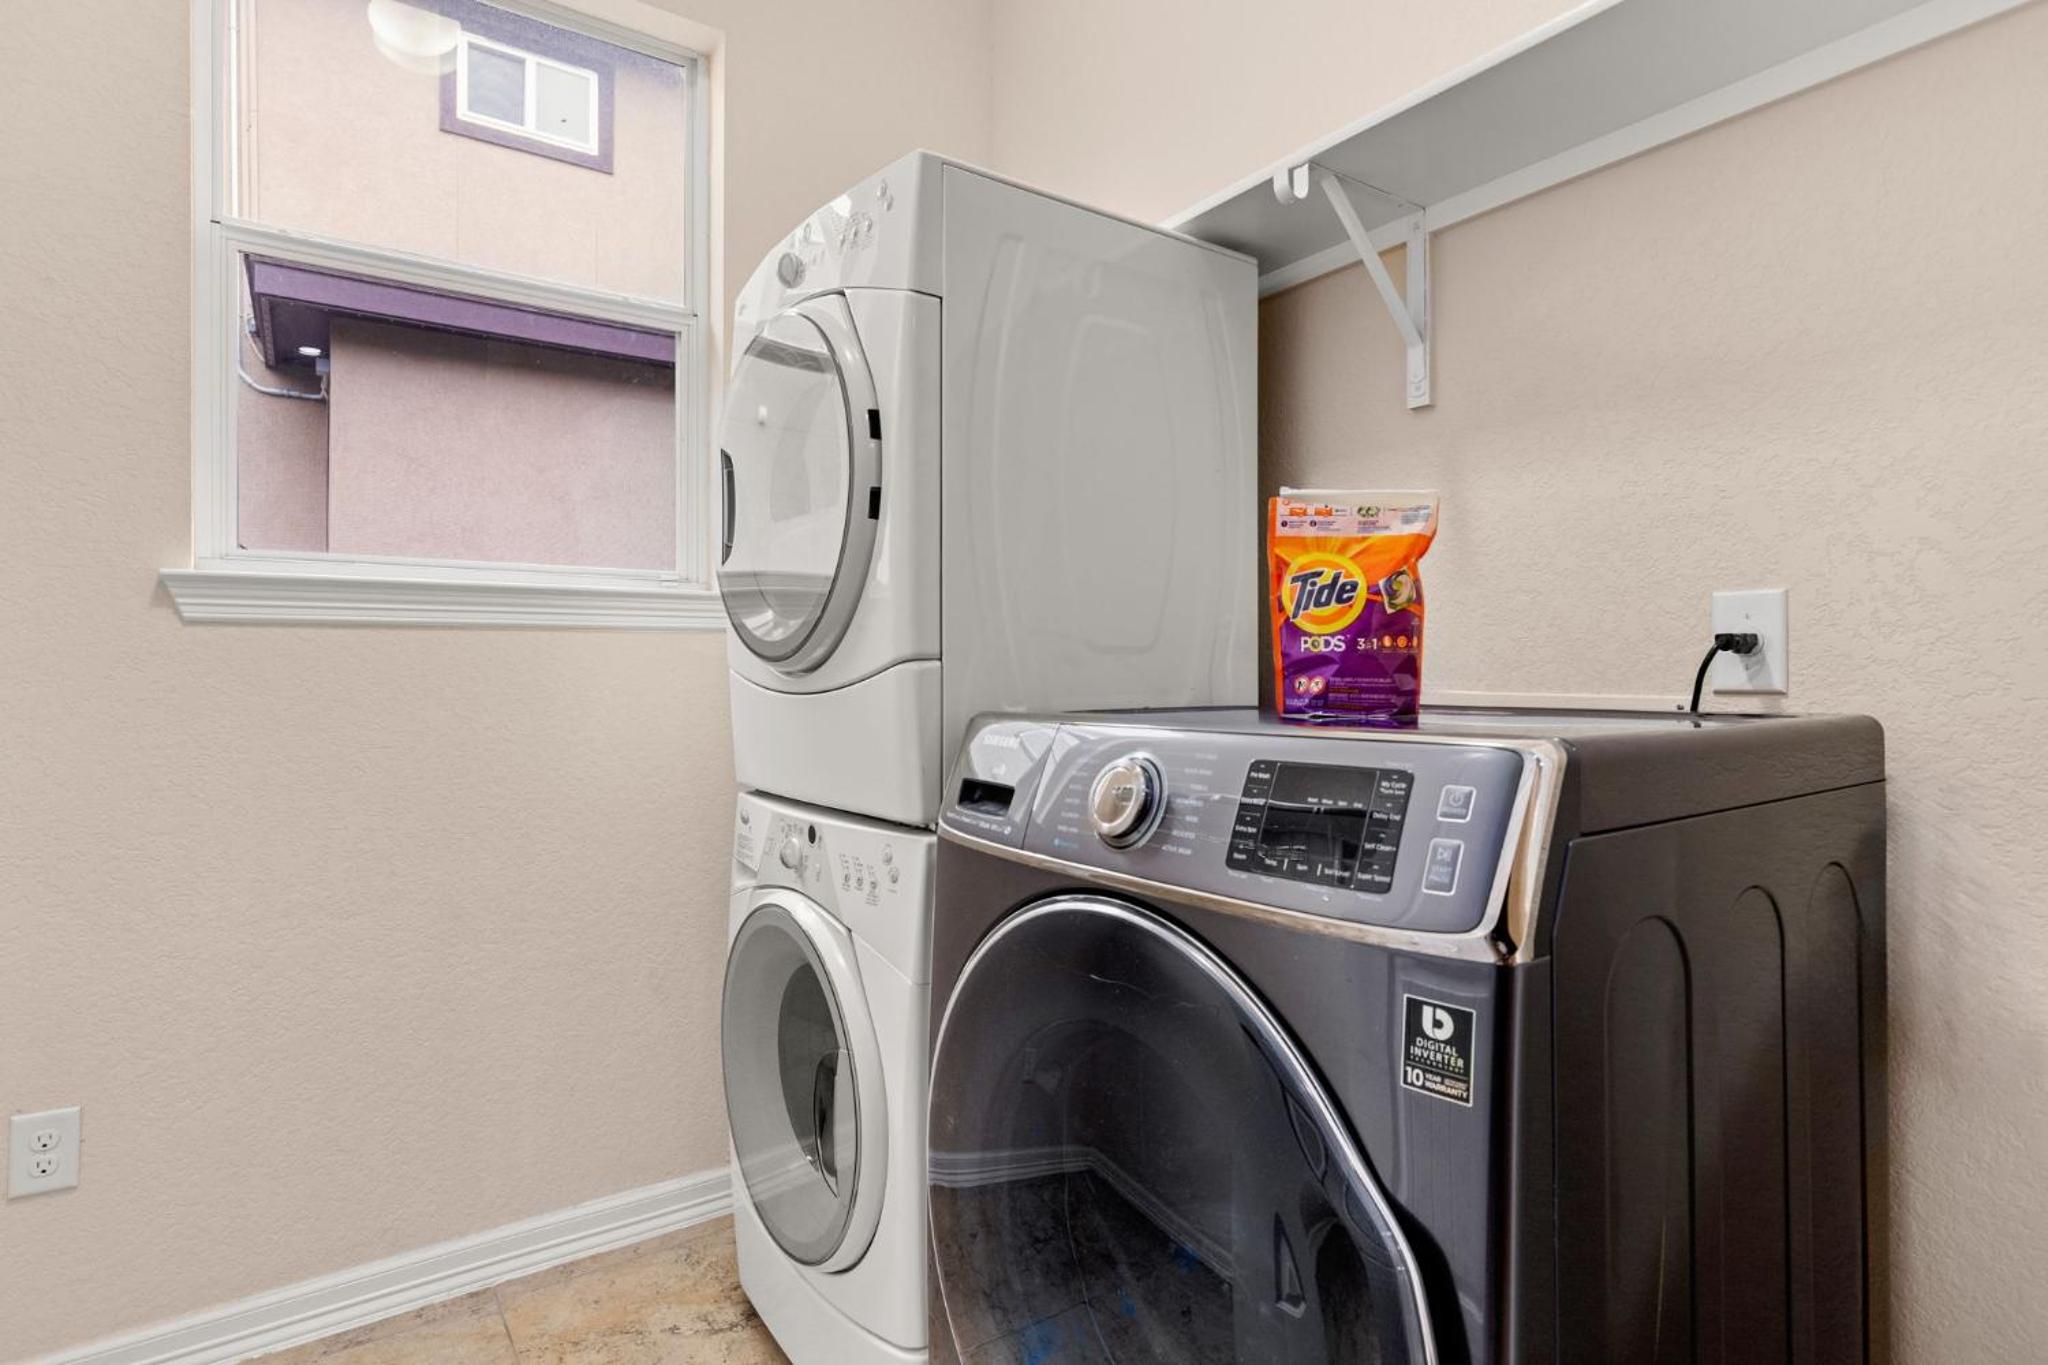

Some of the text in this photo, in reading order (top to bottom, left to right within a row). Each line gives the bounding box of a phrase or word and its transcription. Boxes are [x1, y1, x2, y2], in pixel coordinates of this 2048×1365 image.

[1290, 569, 1359, 620] Tide
[1300, 635, 1346, 652] PODS
[1410, 1045, 1464, 1068] INVERTER
[1416, 1037, 1458, 1057] DIGITAL
[1405, 1066, 1424, 1086] 10
